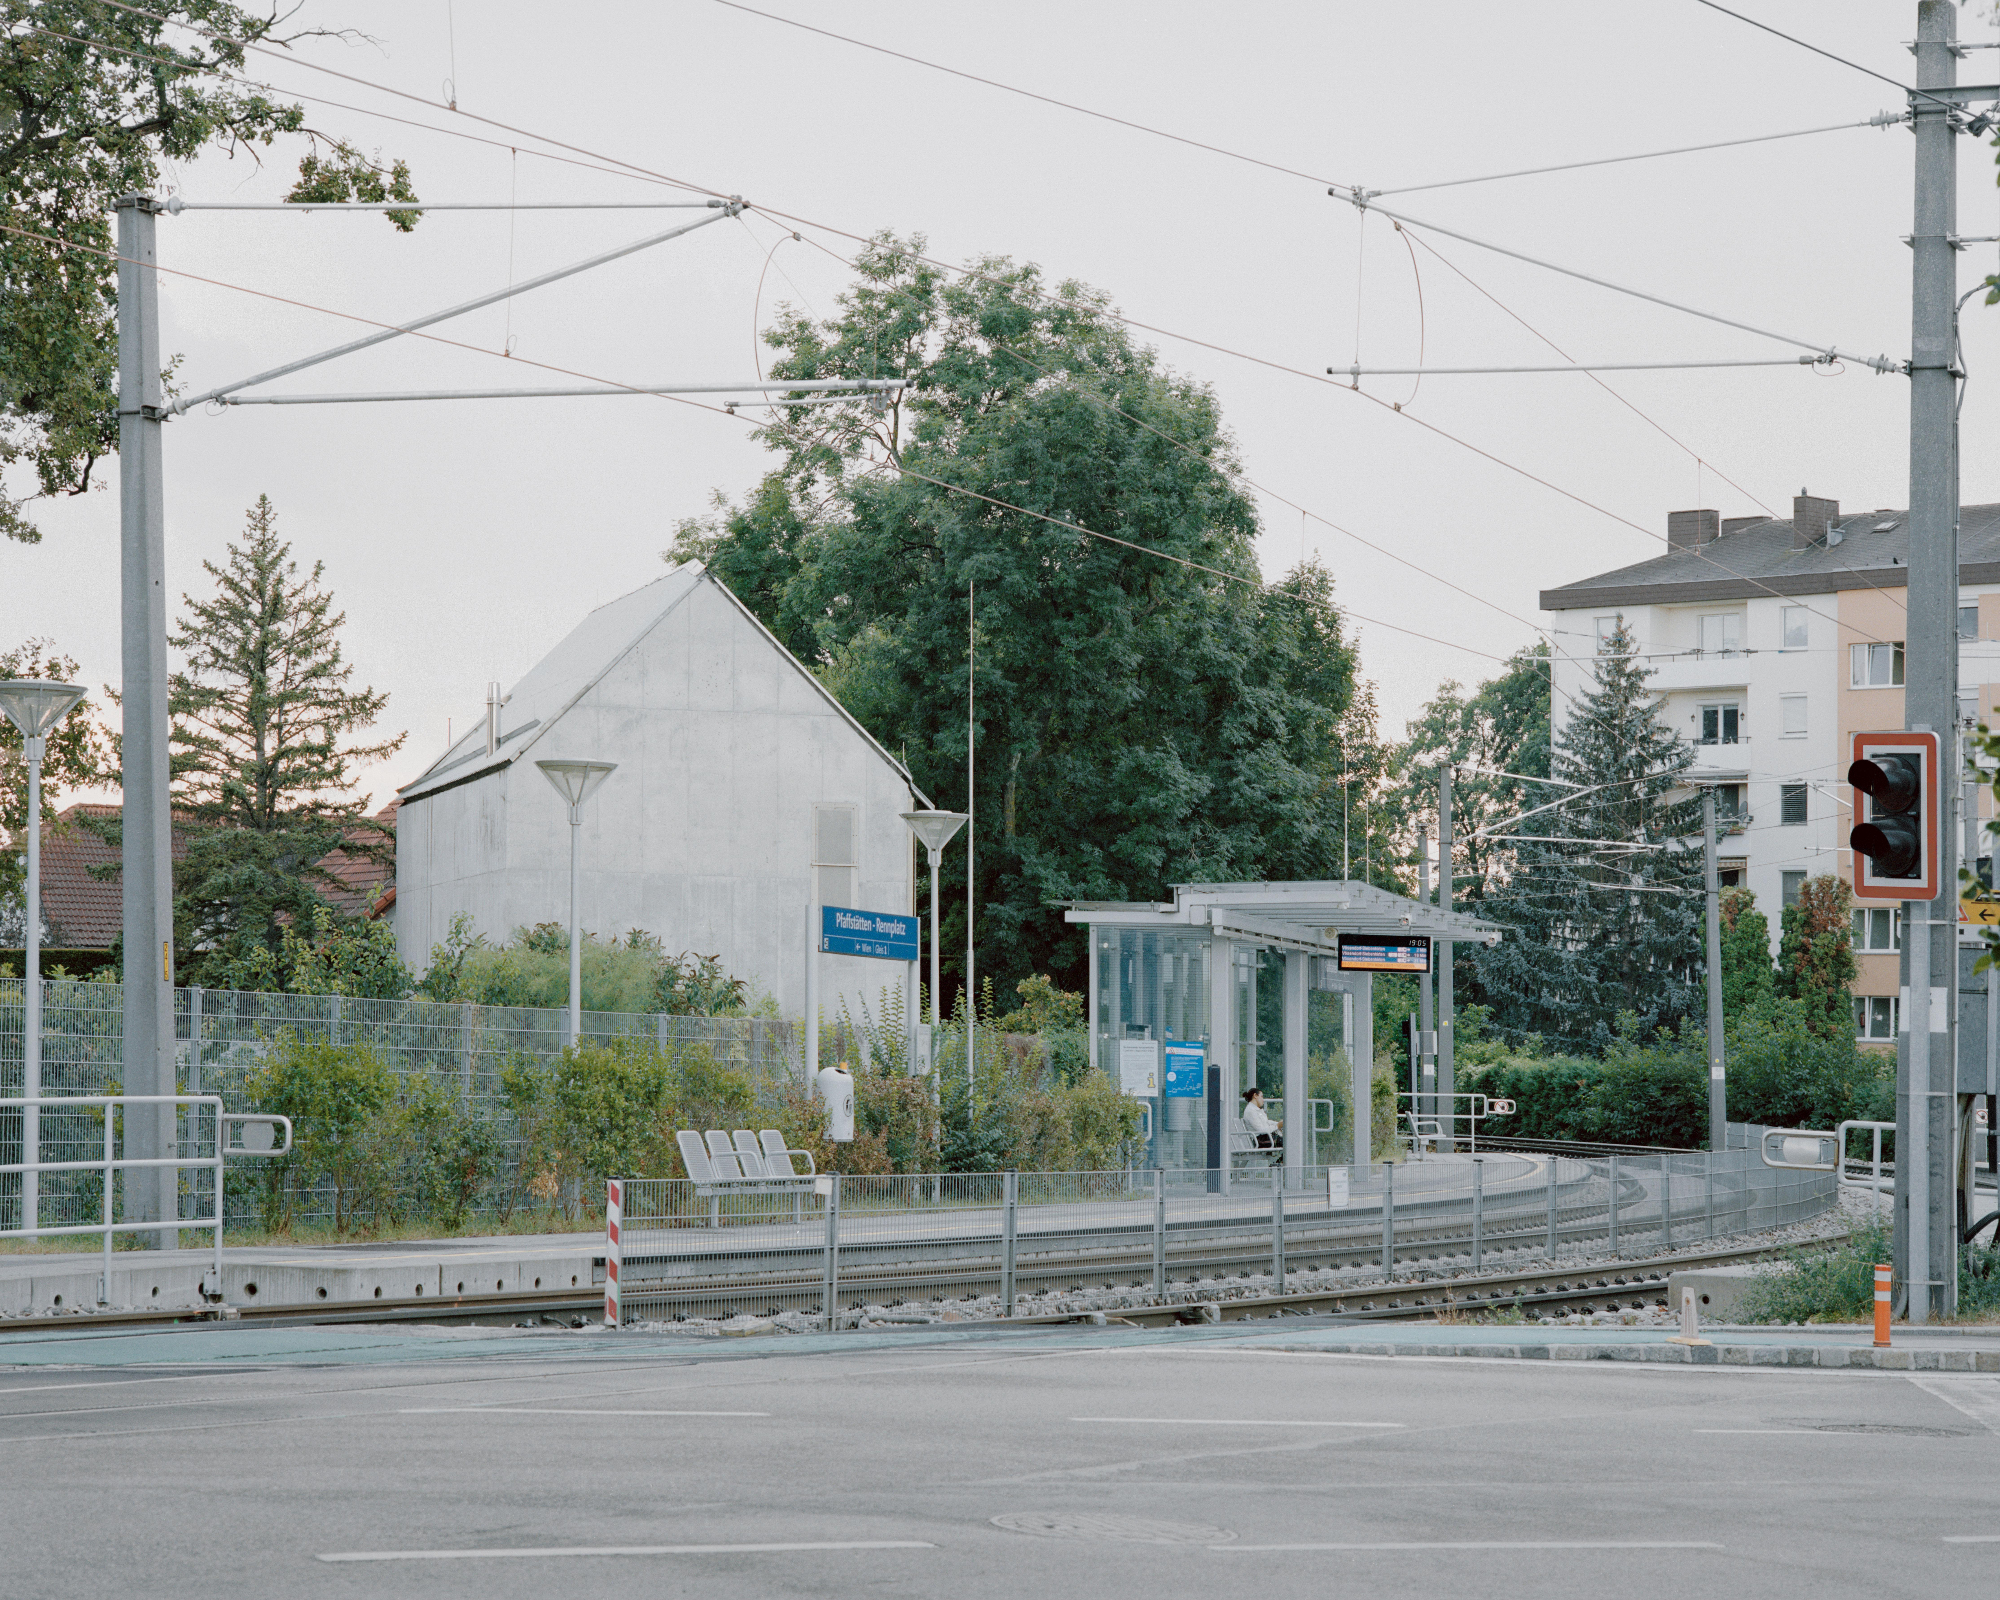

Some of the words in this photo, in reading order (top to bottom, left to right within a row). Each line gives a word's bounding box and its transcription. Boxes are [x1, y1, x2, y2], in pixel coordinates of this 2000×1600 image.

[836, 912, 872, 931] Pfaffstätten
[876, 917, 906, 938] Rennplatz
[861, 943, 872, 953] Wien
[1409, 939, 1427, 947] 19:05
